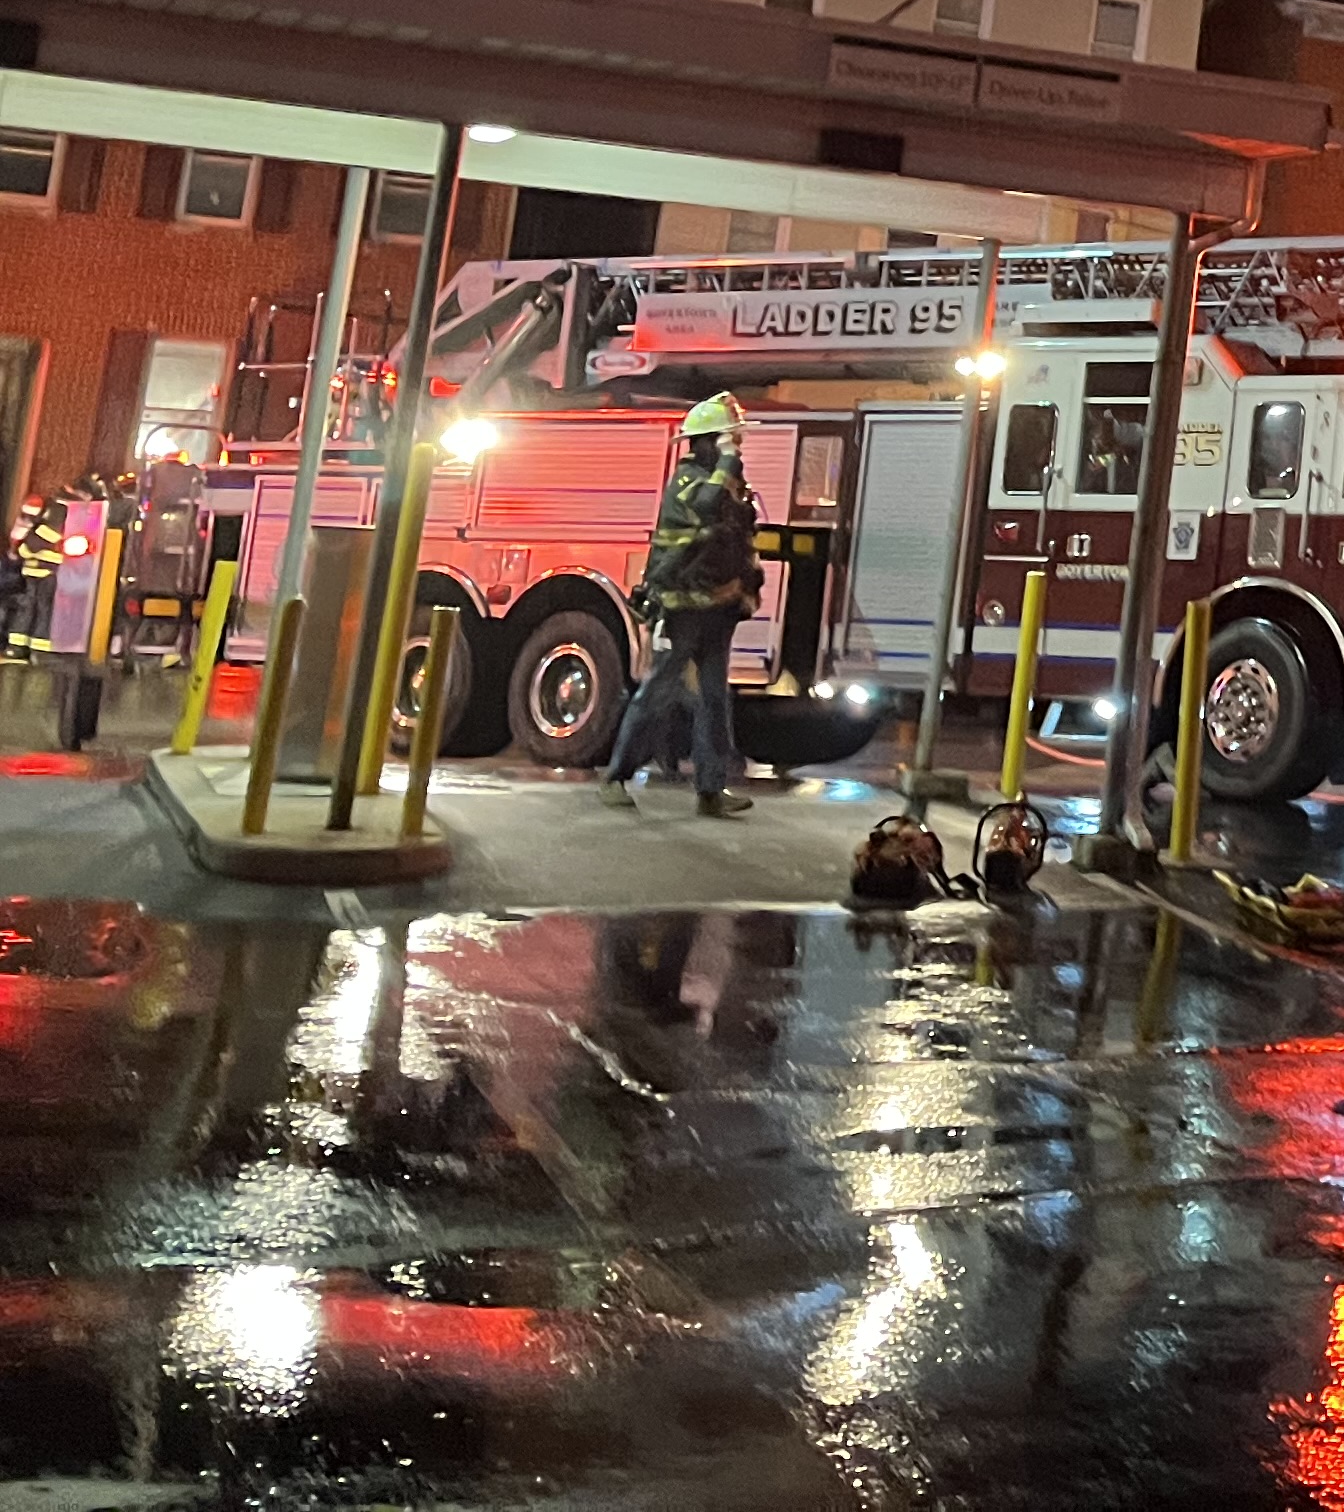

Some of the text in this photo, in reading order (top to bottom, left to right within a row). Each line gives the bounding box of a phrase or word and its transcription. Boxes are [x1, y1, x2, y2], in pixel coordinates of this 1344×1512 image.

[732, 298, 964, 337] LADDER 95
[1179, 422, 1223, 434] ADDER
[1174, 433, 1222, 467] 95
[1056, 563, 1128, 582] BOYERTO
